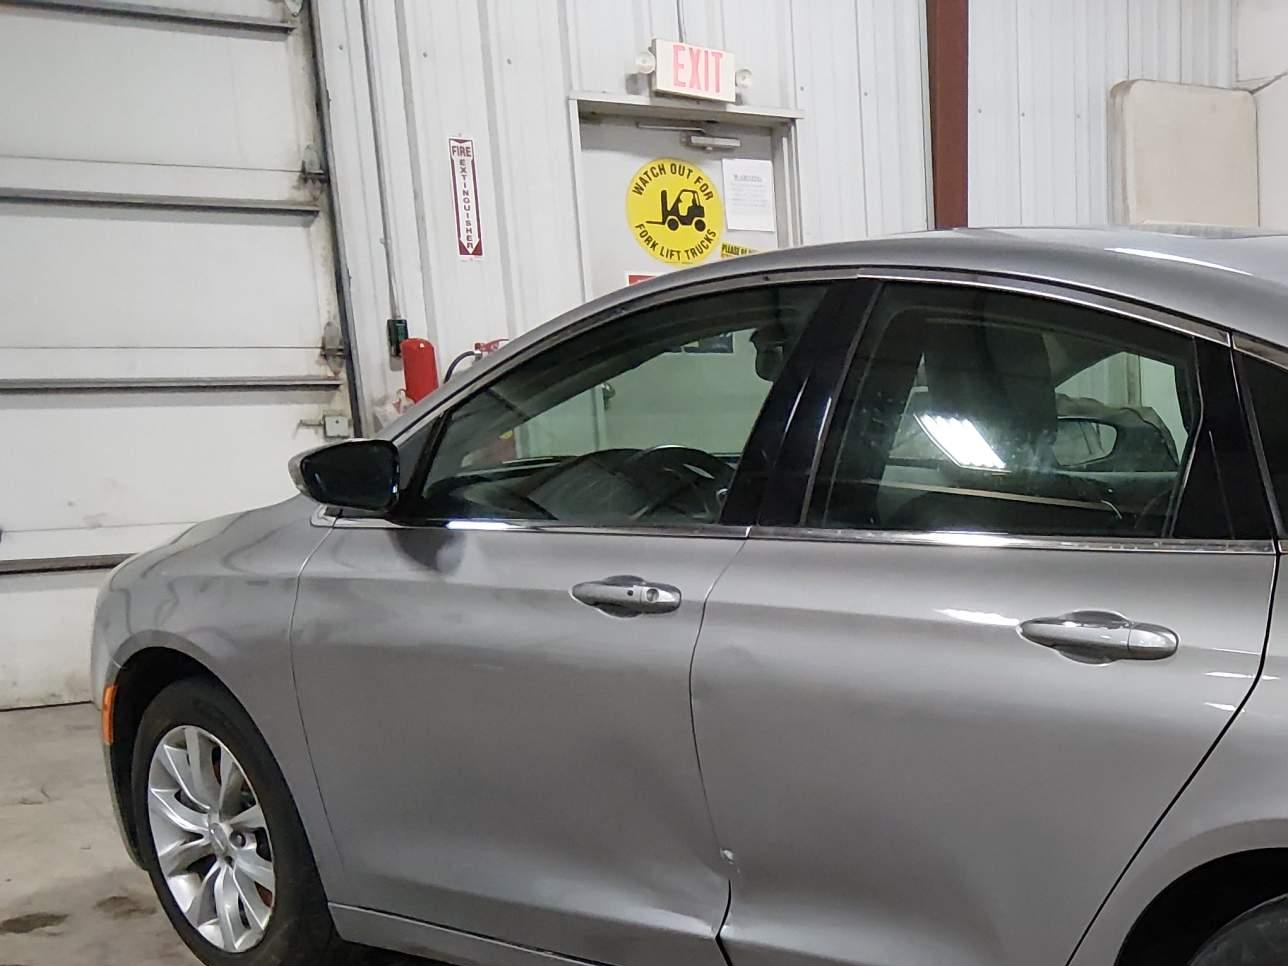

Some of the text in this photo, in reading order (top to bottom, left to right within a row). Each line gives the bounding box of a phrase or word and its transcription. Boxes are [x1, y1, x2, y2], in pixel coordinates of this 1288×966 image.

[672, 44, 724, 93] EXIT
[451, 145, 472, 158] FIRE
[632, 163, 667, 196] WATCH
[670, 162, 693, 180] OUT
[694, 175, 714, 201] FOR
[459, 159, 474, 249] EXTINGUISHER
[634, 223, 717, 261] FORK LIFT TRUCKS
